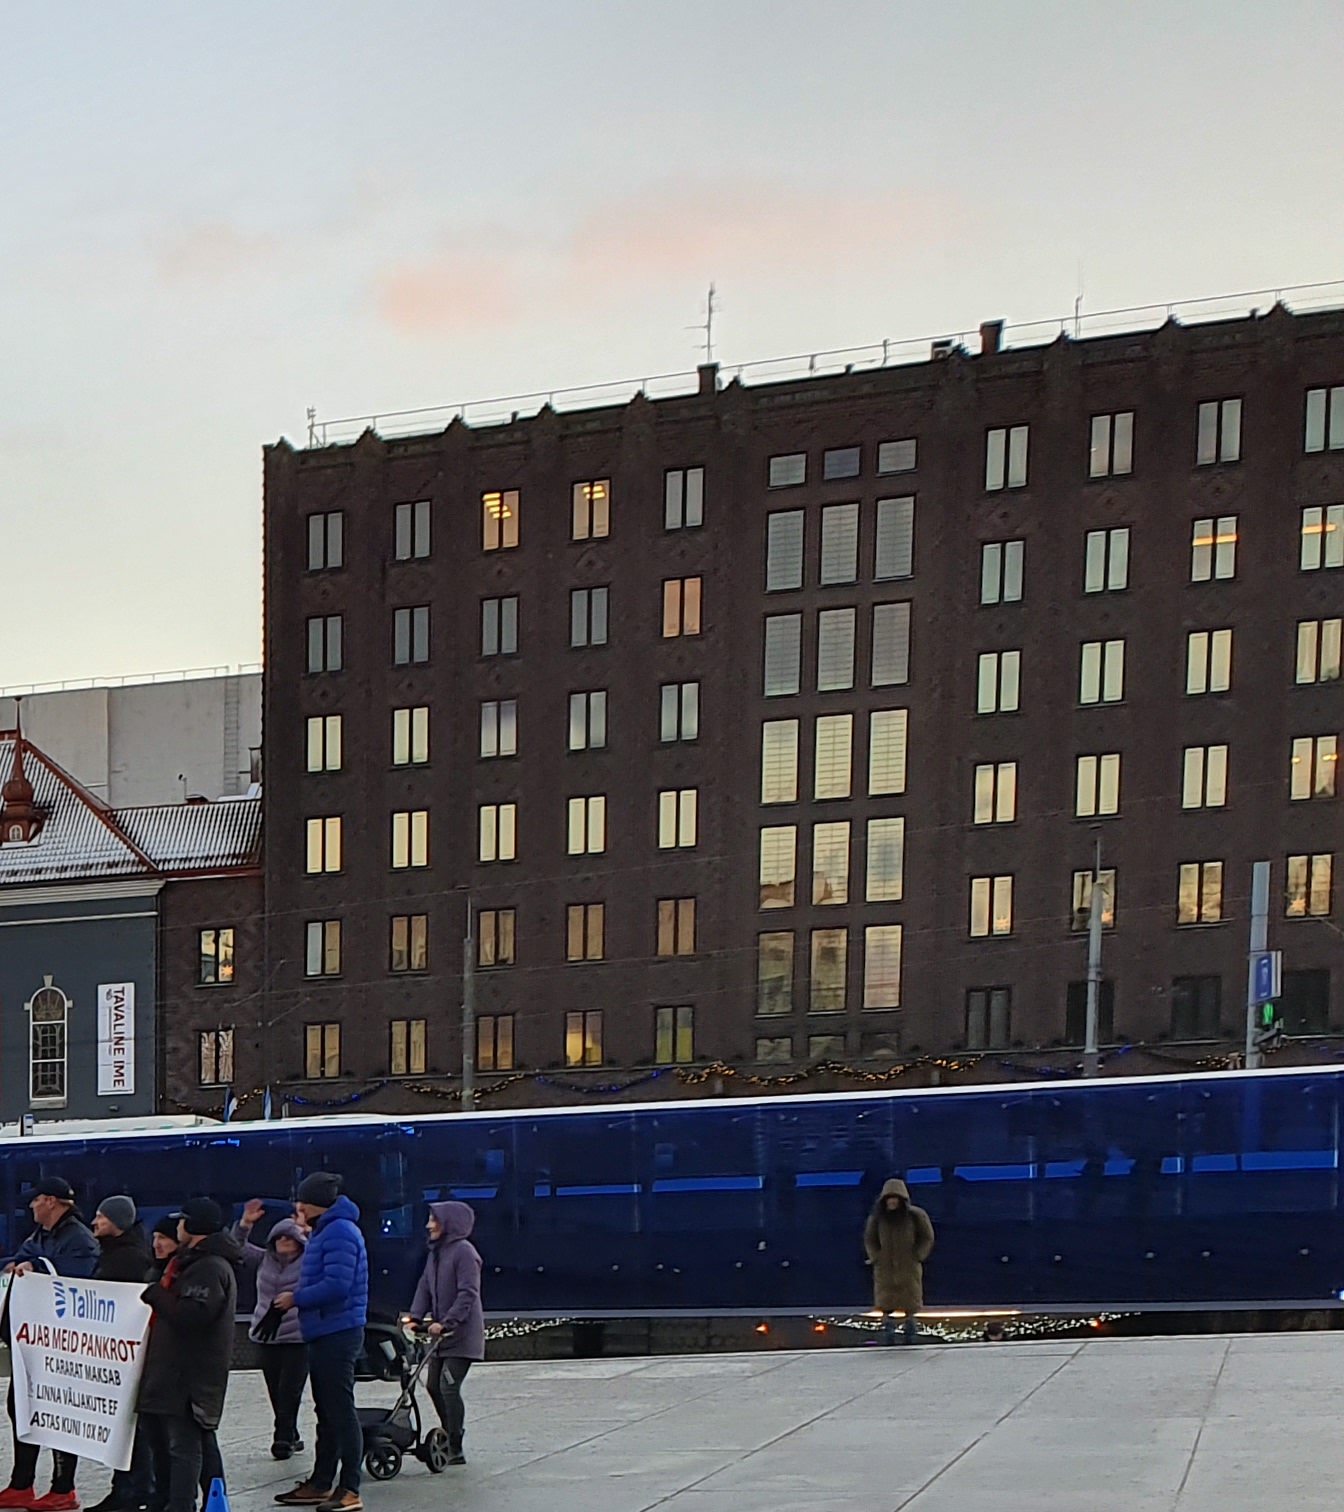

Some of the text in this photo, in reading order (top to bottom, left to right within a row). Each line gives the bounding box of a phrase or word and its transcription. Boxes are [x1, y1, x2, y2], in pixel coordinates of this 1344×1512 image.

[113, 986, 125, 1087] TAVALINE IME
[69, 1288, 115, 1323] Tallinn
[16, 1323, 49, 1347] AJAB
[52, 1327, 78, 1353] MEID
[45, 1356, 121, 1386] FC ARARAT MAKSAB
[37, 1384, 61, 1404] LINNA
[62, 1387, 107, 1415] VÄLJAKUTE
[62, 1417, 81, 1436] KUNI
[83, 1422, 96, 1440] 10X
